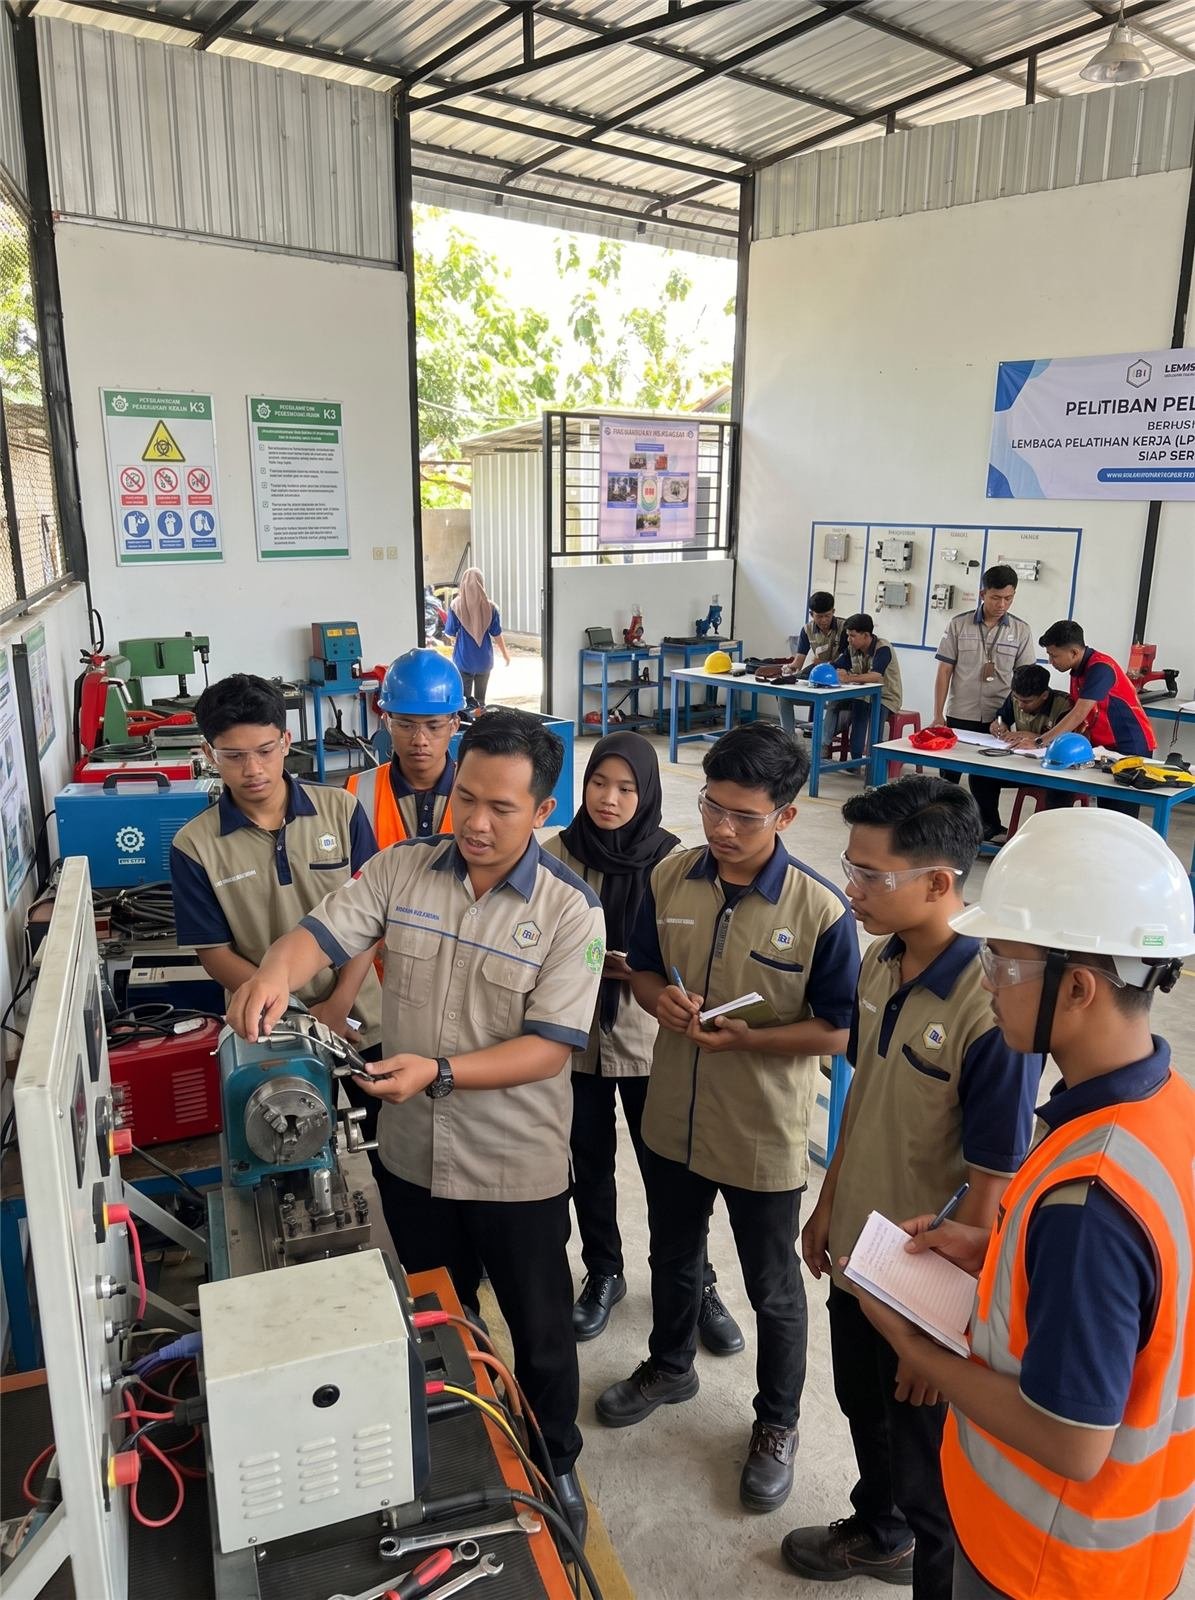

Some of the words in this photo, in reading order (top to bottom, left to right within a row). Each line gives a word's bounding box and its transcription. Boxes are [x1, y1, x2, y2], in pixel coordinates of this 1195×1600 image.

[189, 401, 205, 414] K3
[1065, 397, 1157, 416] PELITIBAN
[323, 409, 337, 420] K3
[1011, 438, 1062, 449] LEMBAGA
[1065, 436, 1129, 448] PELATIHAN
[1133, 435, 1171, 447] KERJA
[1138, 450, 1167, 461] SIAP
